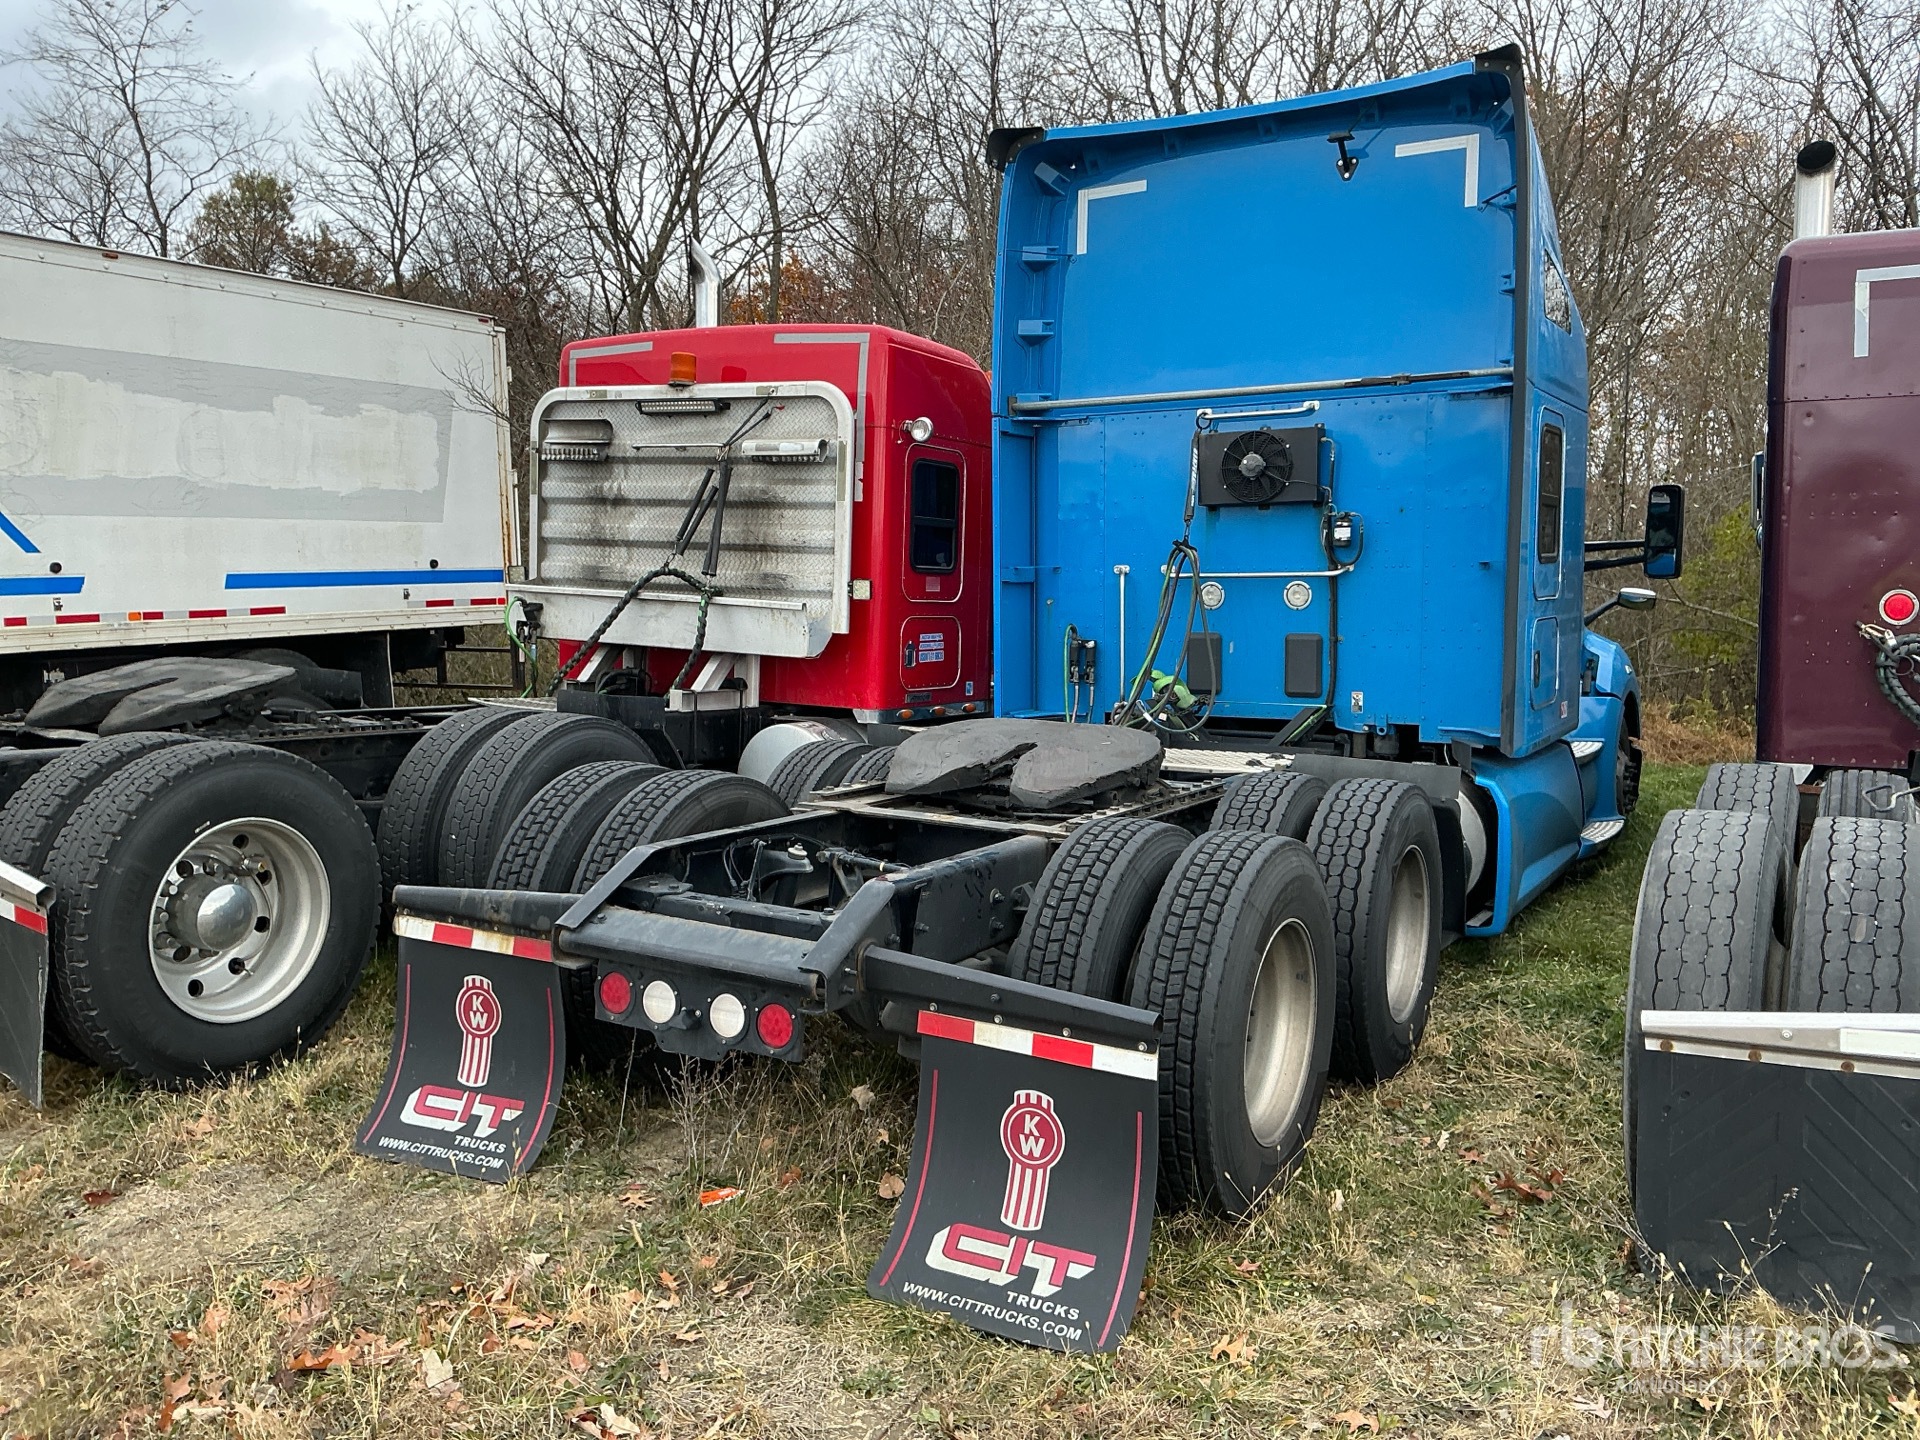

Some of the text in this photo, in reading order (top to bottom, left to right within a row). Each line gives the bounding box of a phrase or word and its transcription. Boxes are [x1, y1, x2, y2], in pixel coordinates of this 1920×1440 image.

[400, 1084, 525, 1138] CIT
[378, 1136, 504, 1169] WWW.CITTRUCKS.COM
[454, 1134, 507, 1154] TRUCKS
[925, 1222, 1097, 1298] CIT
[902, 1281, 1083, 1342] WWW.CITTRUCKS.COM
[1006, 1290, 1080, 1321] TRUCKS
